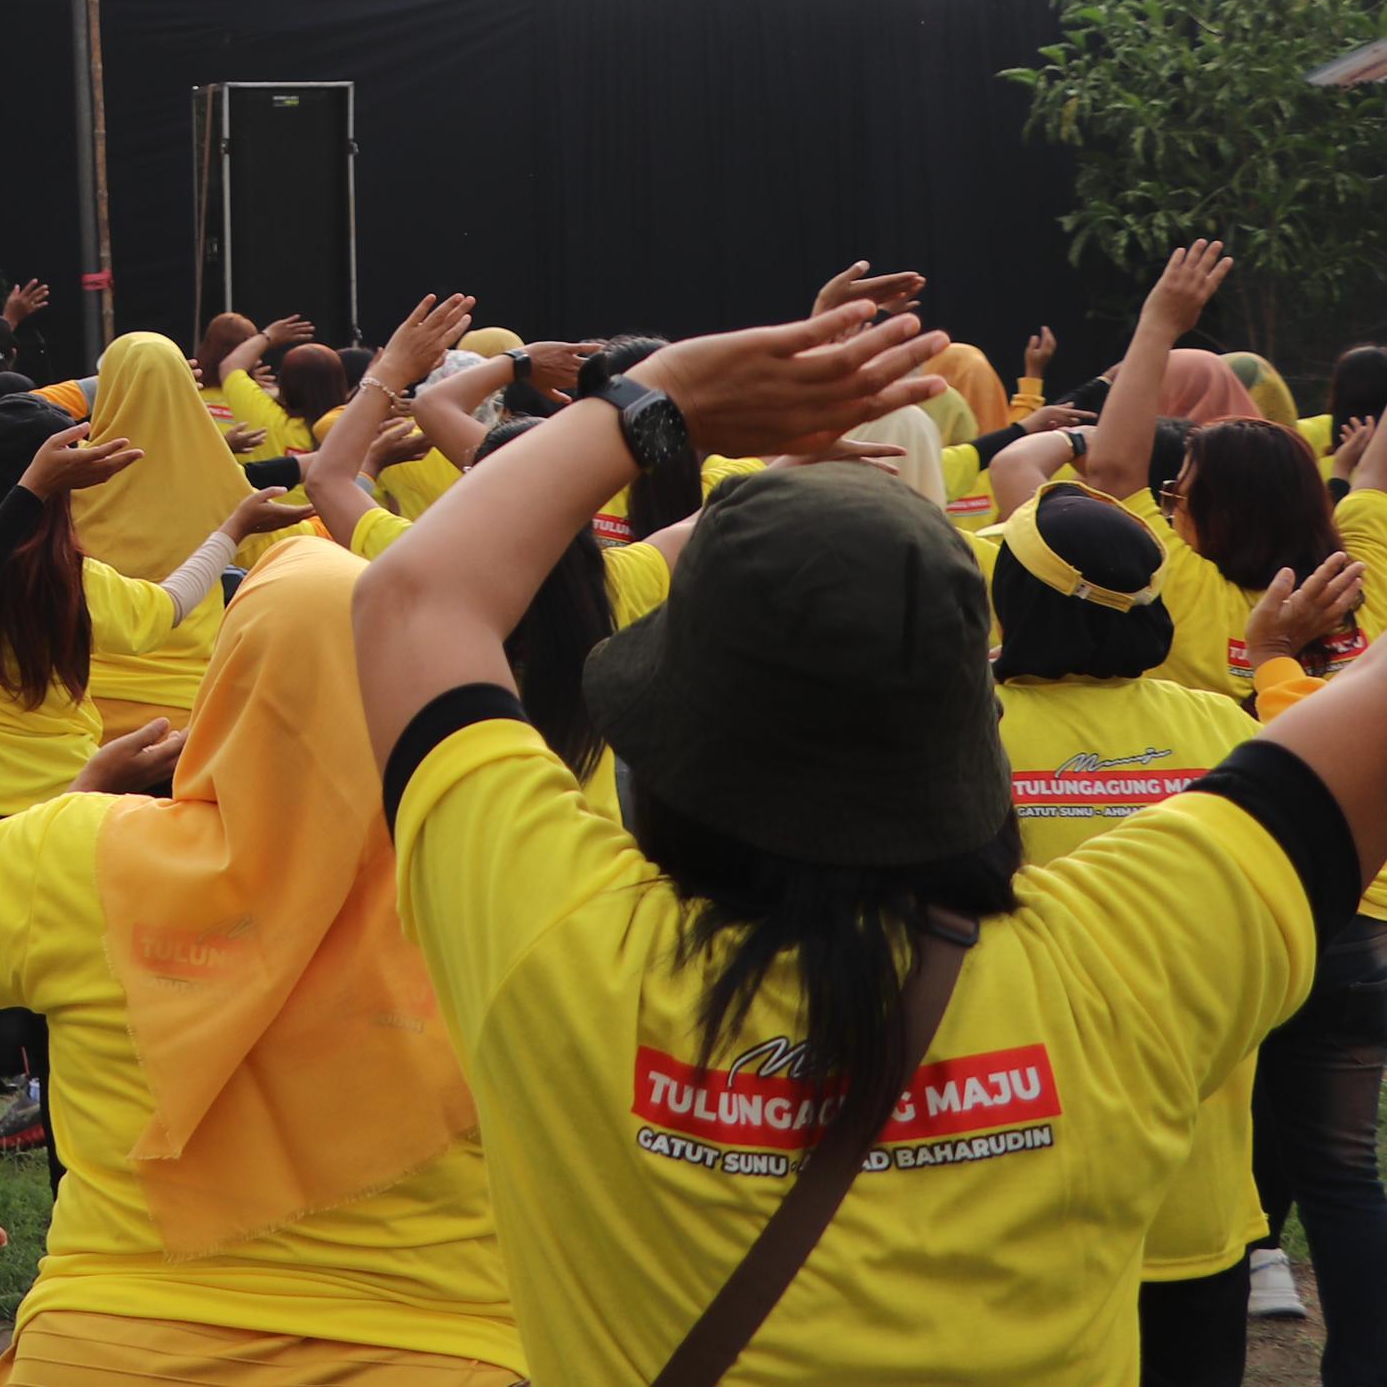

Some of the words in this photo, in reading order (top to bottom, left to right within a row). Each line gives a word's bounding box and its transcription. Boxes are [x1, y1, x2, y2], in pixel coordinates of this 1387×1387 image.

[1013, 779, 1162, 796] TULUNGAGUNG
[1017, 805, 1058, 818] GATUT
[1059, 805, 1094, 818] SUNU
[925, 1066, 1043, 1117] MAJU
[637, 1125, 721, 1170] GATUT
[721, 1151, 790, 1177] SUNU
[894, 1124, 1054, 1171] BAHARUDIN
